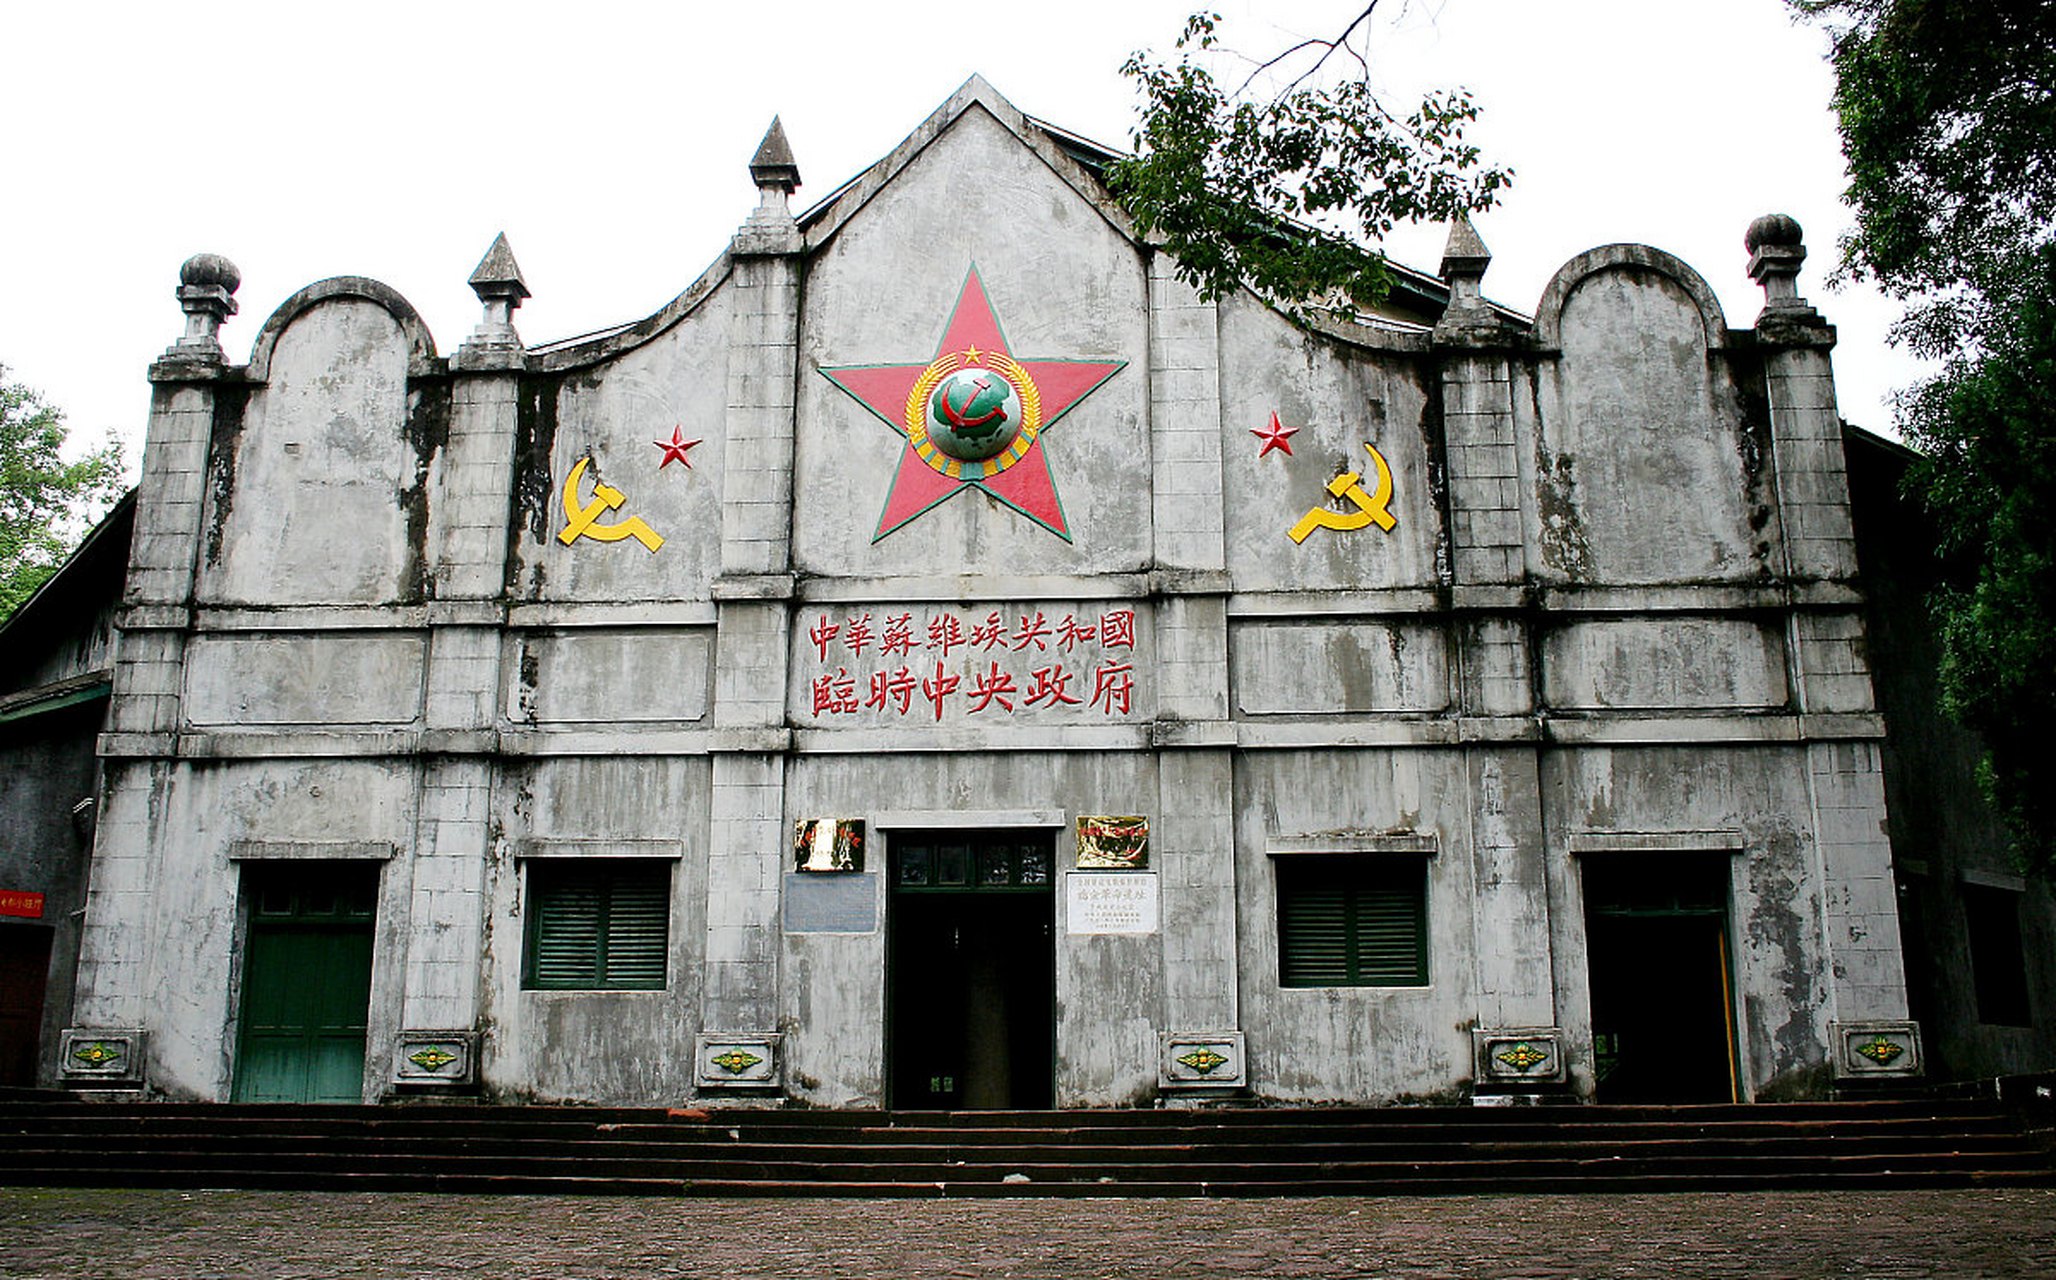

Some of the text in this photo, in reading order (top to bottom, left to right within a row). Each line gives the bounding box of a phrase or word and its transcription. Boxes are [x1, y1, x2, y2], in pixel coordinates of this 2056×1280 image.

[809, 610, 1135, 663] 中華蘇維埃共和國
[812, 659, 1134, 723] 臨時中央政府
